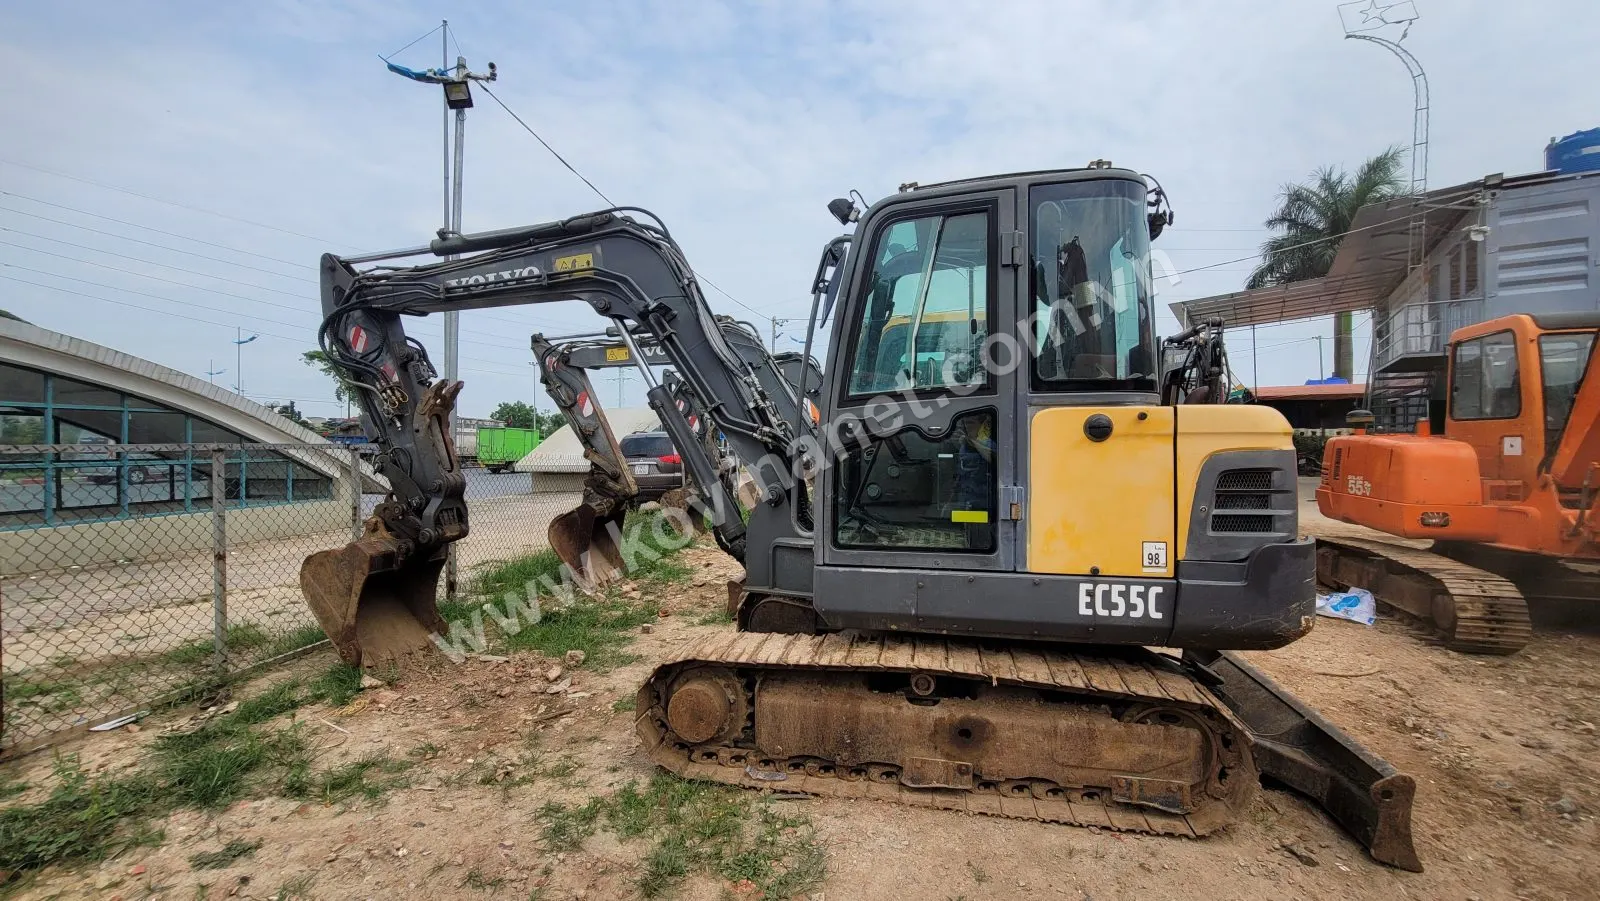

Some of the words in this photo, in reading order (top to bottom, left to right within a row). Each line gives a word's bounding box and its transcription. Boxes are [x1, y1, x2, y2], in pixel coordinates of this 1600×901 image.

[446, 266, 540, 292] VOLVO
[1147, 552, 1160, 565] 98
[1079, 583, 1163, 619] EC55C
